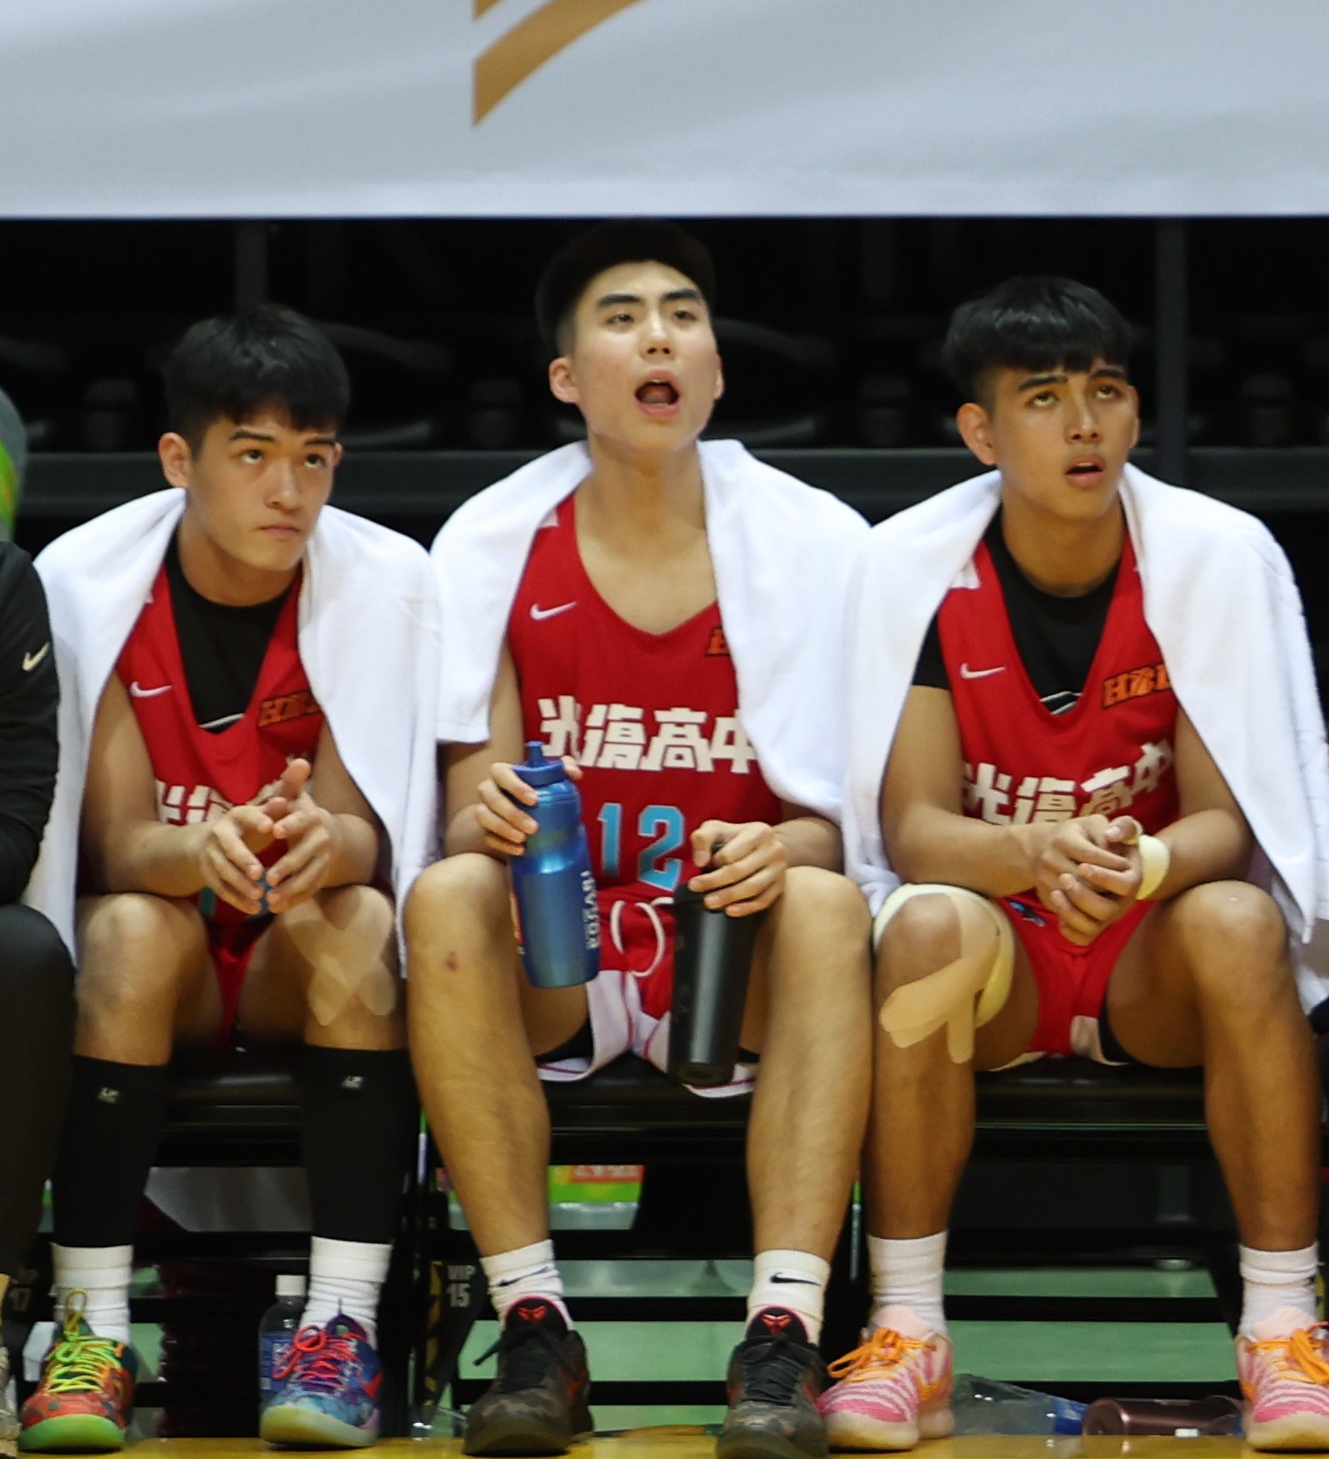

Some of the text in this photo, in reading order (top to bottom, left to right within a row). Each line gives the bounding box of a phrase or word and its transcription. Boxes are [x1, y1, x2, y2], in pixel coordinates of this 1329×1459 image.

[597, 802, 685, 892] 12
[447, 1265, 476, 1280] VIP
[446, 1283, 471, 1308] 15
